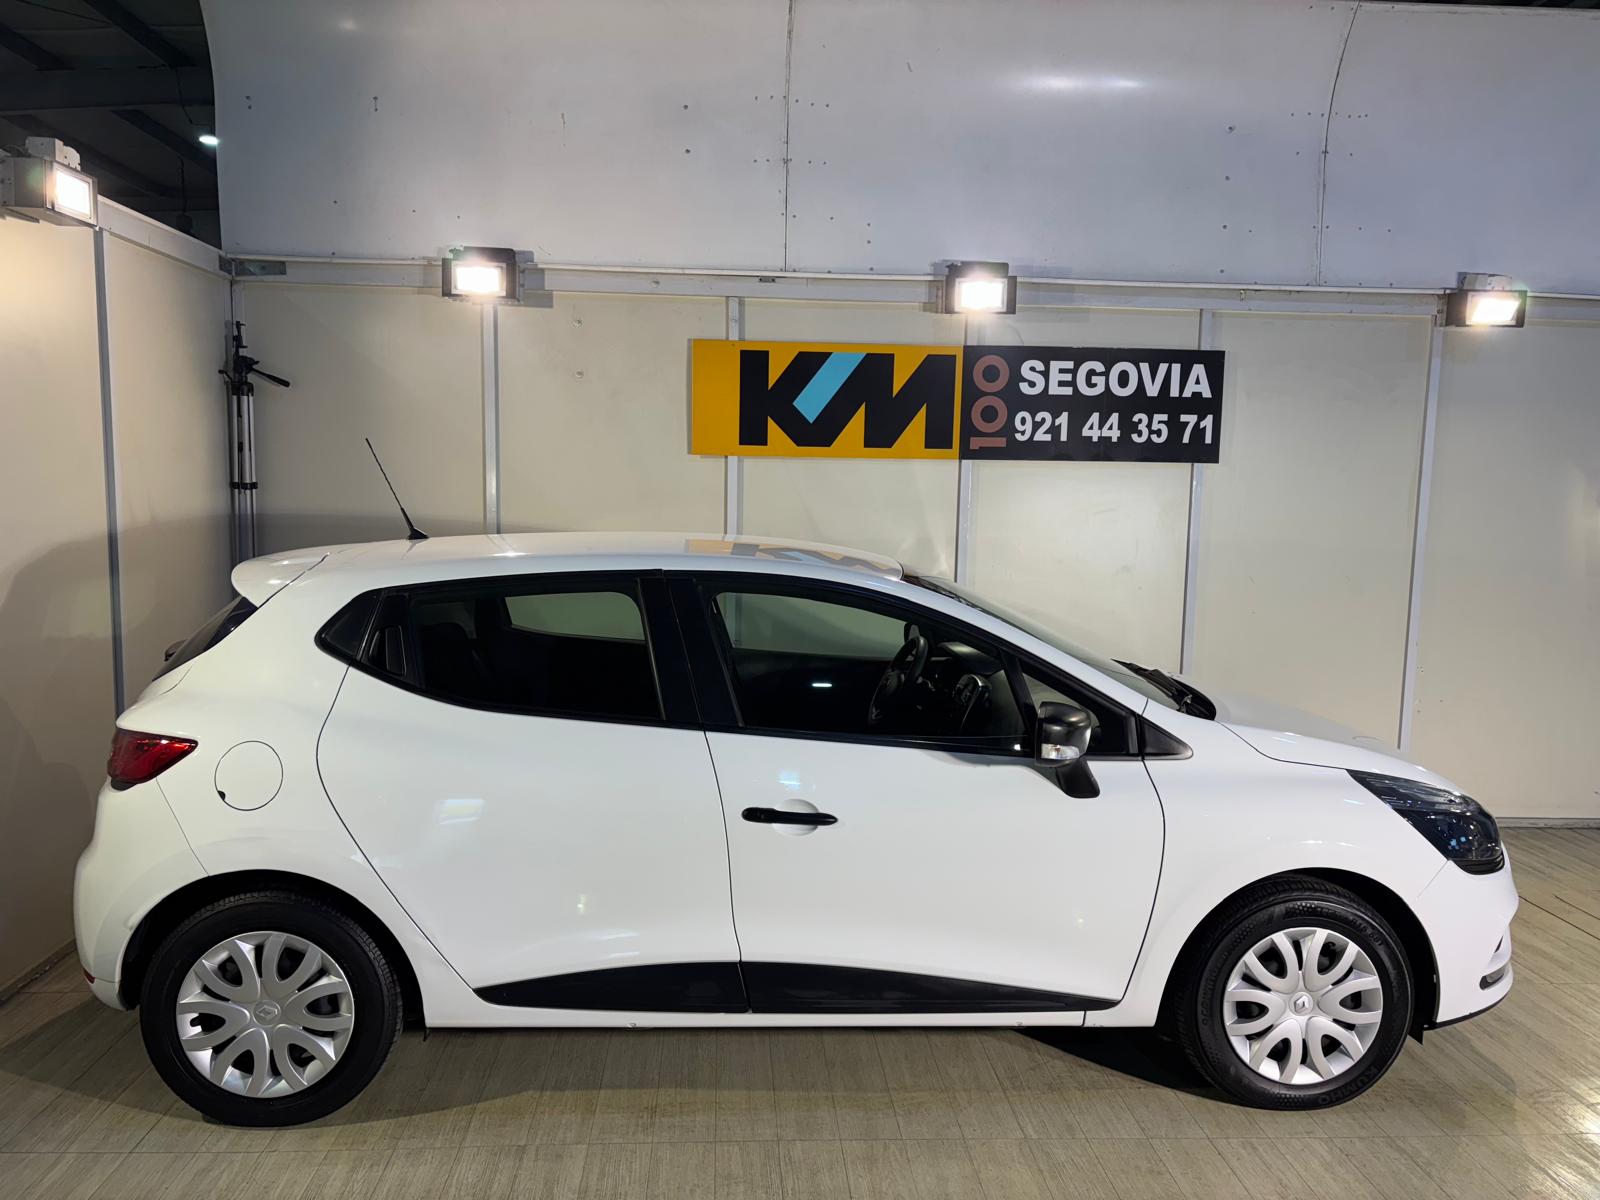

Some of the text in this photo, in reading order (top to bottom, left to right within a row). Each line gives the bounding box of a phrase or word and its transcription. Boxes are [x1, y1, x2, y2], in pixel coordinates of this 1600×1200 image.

[739, 349, 956, 450] KM
[970, 354, 1010, 450] 100
[1018, 359, 1212, 399] SEGOVIA
[1014, 410, 1214, 444] 921 44 35 71
